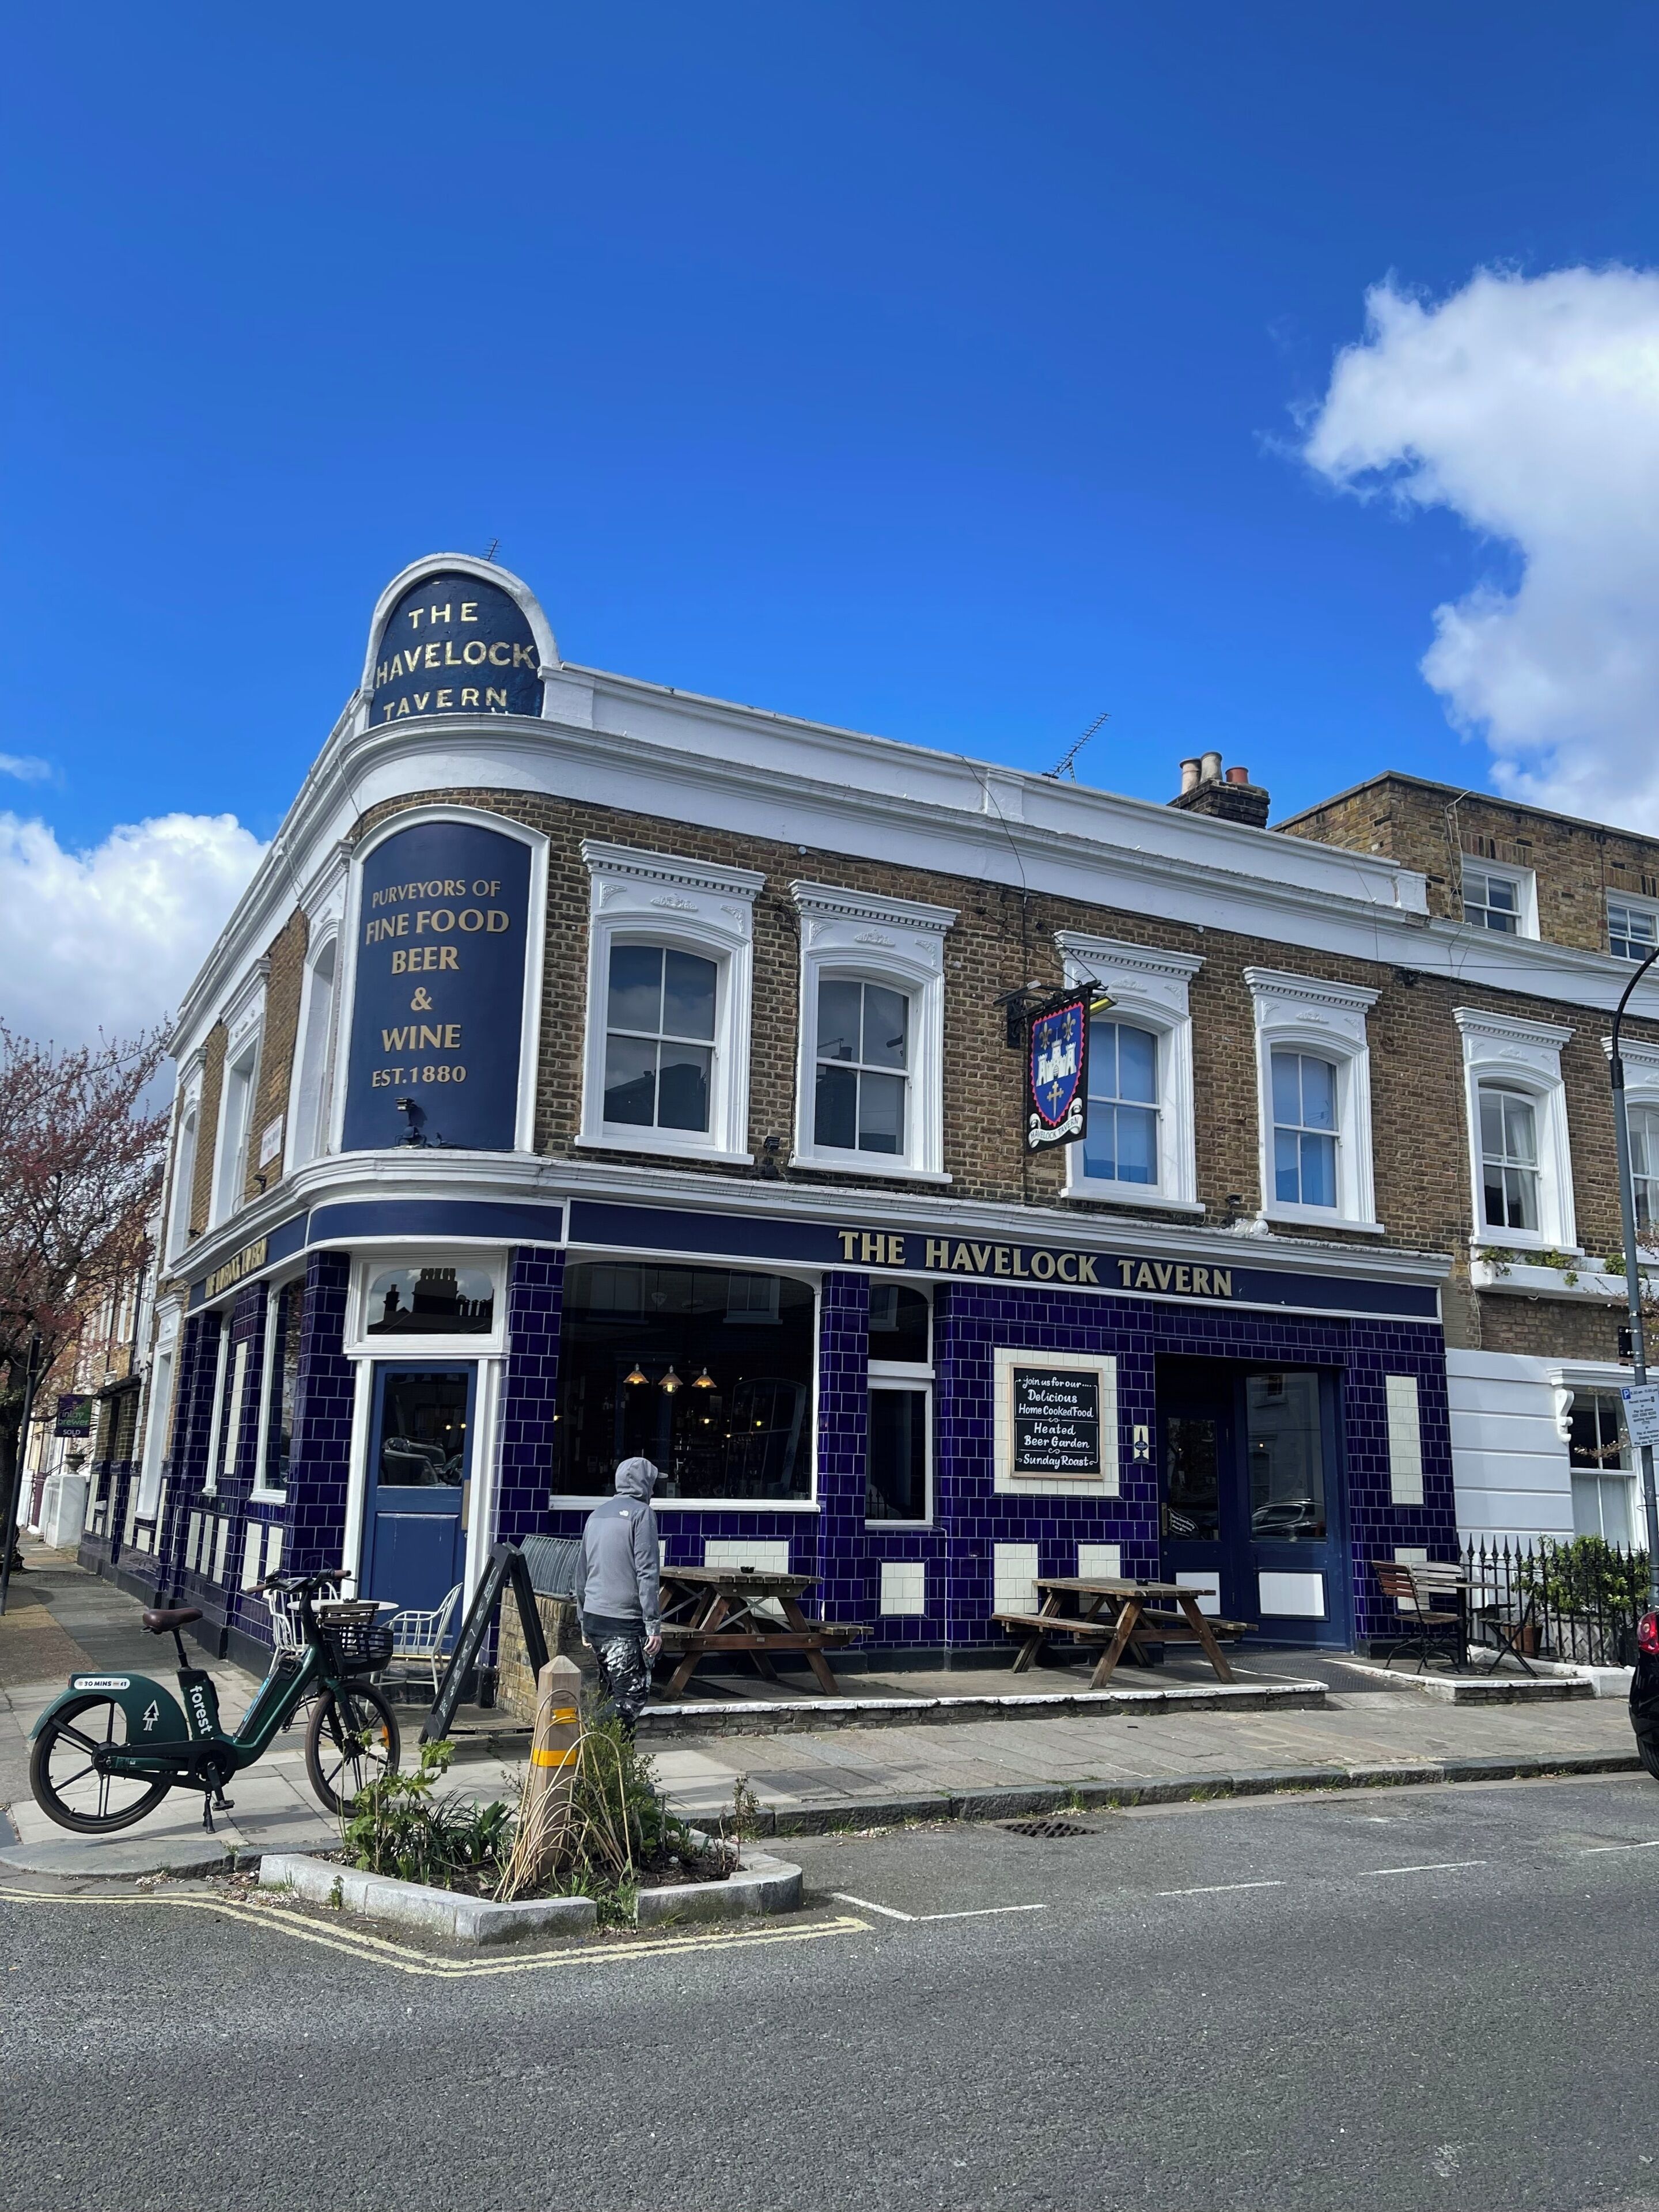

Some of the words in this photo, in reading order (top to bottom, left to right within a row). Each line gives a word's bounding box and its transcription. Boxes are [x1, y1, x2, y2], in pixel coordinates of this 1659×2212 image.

[408, 602, 479, 629] THE
[376, 641, 536, 689] HAVELOCK
[384, 686, 507, 721] TAVERN
[372, 879, 466, 908] PURVEYORS
[472, 879, 501, 897] OF
[365, 912, 409, 945] FINE
[415, 908, 510, 934] FOOD
[391, 946, 460, 975] BEER
[410, 987, 433, 1011] &
[381, 1024, 461, 1052] WINE
[1031, 1130, 1056, 1139] HAVELOCK
[1058, 1116, 1079, 1135] TAVERN
[838, 1230, 907, 1265] THE
[925, 1239, 1100, 1284] HAVELOCK
[1118, 1259, 1233, 1297] TAVERN
[1022, 1375, 1040, 1389] join
[1051, 1377, 1064, 1387] for
[1027, 1389, 1078, 1403] Delicious
[1018, 1403, 1042, 1415] Home
[1043, 1406, 1073, 1416] Cooked
[1073, 1406, 1094, 1418] Food
[1024, 1435, 1050, 1446] Beer
[1051, 1435, 1090, 1448] Garden
[1033, 1422, 1077, 1435] Heated
[1023, 1453, 1060, 1469] Sunday
[1061, 1455, 1089, 1467] Roast
[190, 1685, 213, 1734] forest
